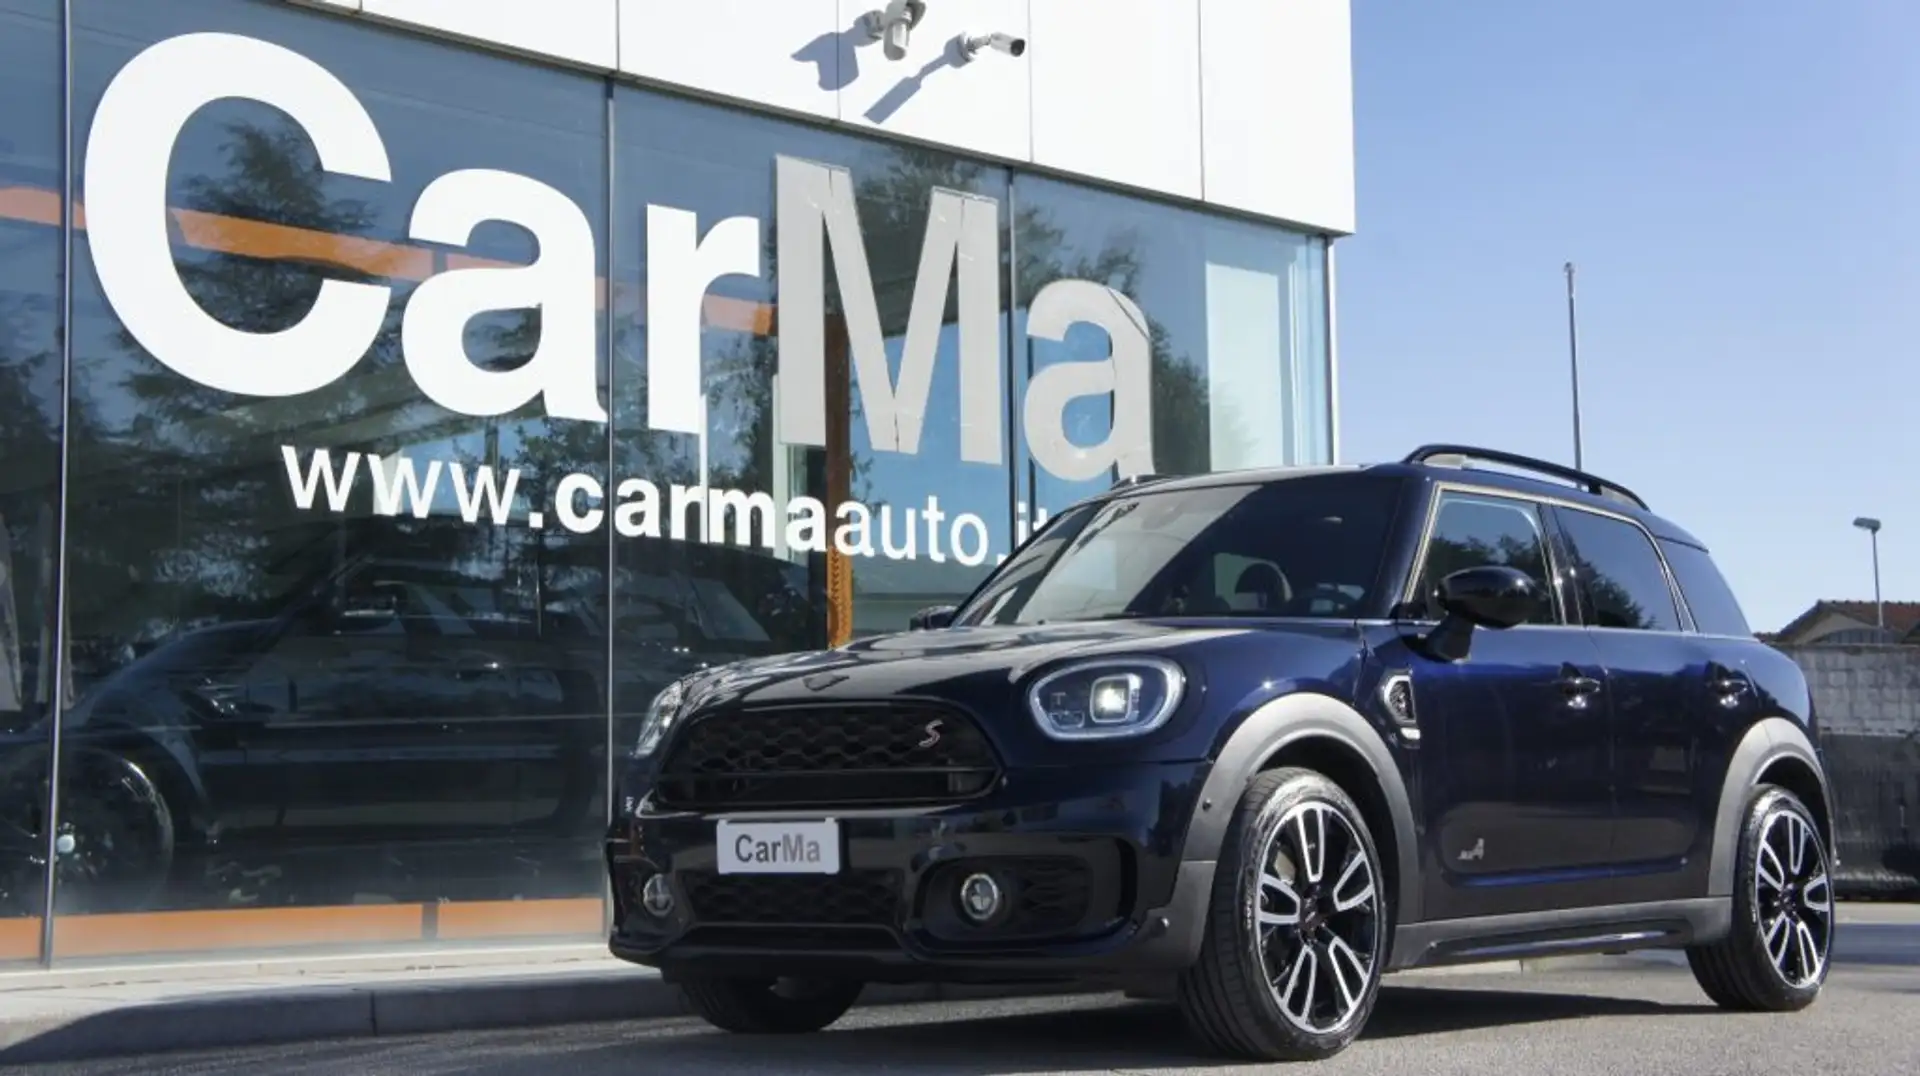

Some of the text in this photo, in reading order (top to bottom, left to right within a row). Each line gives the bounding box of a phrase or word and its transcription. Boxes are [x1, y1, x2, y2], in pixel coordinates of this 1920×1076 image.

[84, 32, 1155, 480] CarMa
[918, 719, 944, 748] S
[735, 833, 821, 863] CarMa
